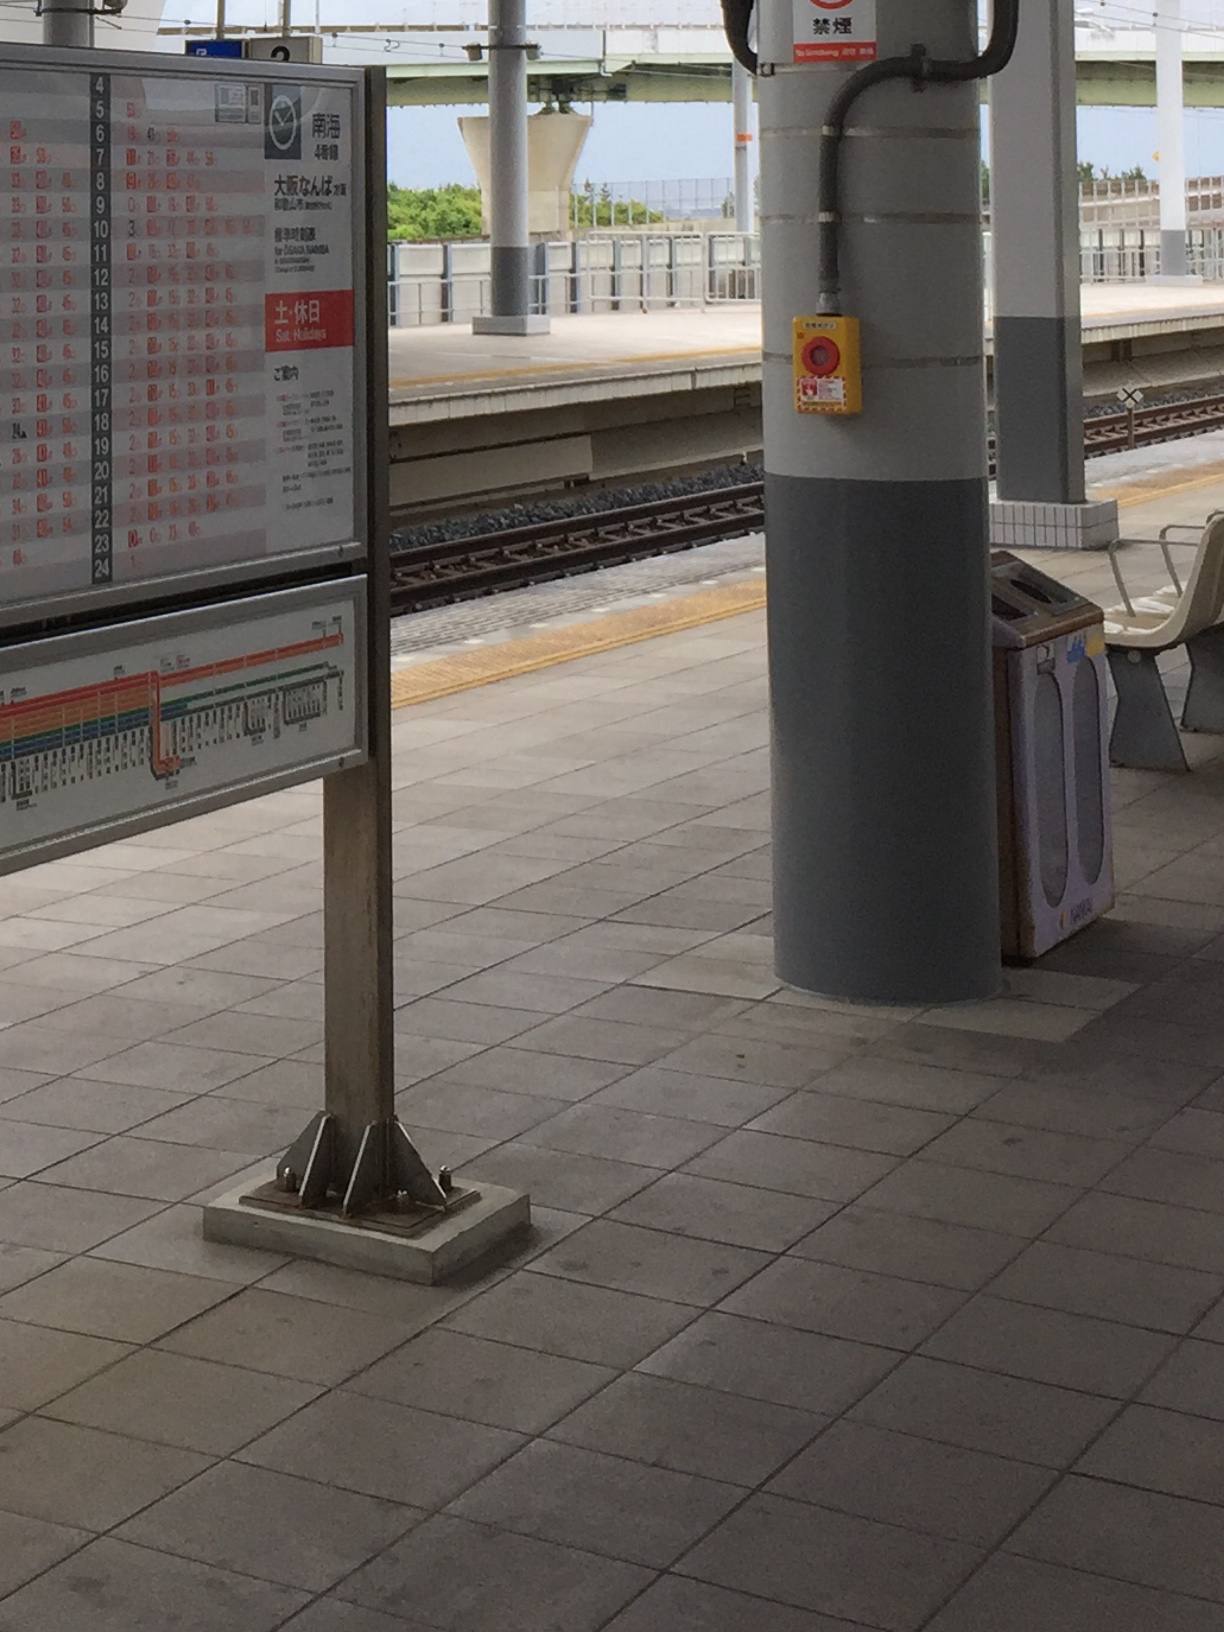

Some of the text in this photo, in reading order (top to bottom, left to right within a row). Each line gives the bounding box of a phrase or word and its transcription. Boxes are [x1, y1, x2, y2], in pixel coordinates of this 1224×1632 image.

[812, 17, 852, 35] 禁煙
[96, 77, 103, 93] 4
[96, 101, 104, 118] 5
[96, 125, 104, 142] 6
[312, 113, 340, 139] 南海
[97, 149, 103, 165] 7
[97, 172, 104, 190] 8
[97, 196, 104, 214] 9
[94, 220, 108, 237] 10
[94, 245, 106, 261] 11
[95, 269, 108, 285] 12
[95, 292, 108, 310] 13
[95, 317, 108, 333] 14
[95, 341, 108, 358] 15
[95, 365, 108, 382] 16
[95, 389, 108, 406] 17
[95, 413, 109, 430] 18
[95, 437, 109, 455] 19
[95, 461, 109, 480] 20
[95, 486, 107, 504] 21
[95, 510, 108, 528] 22
[95, 535, 109, 553] 23
[95, 559, 109, 577] 24
